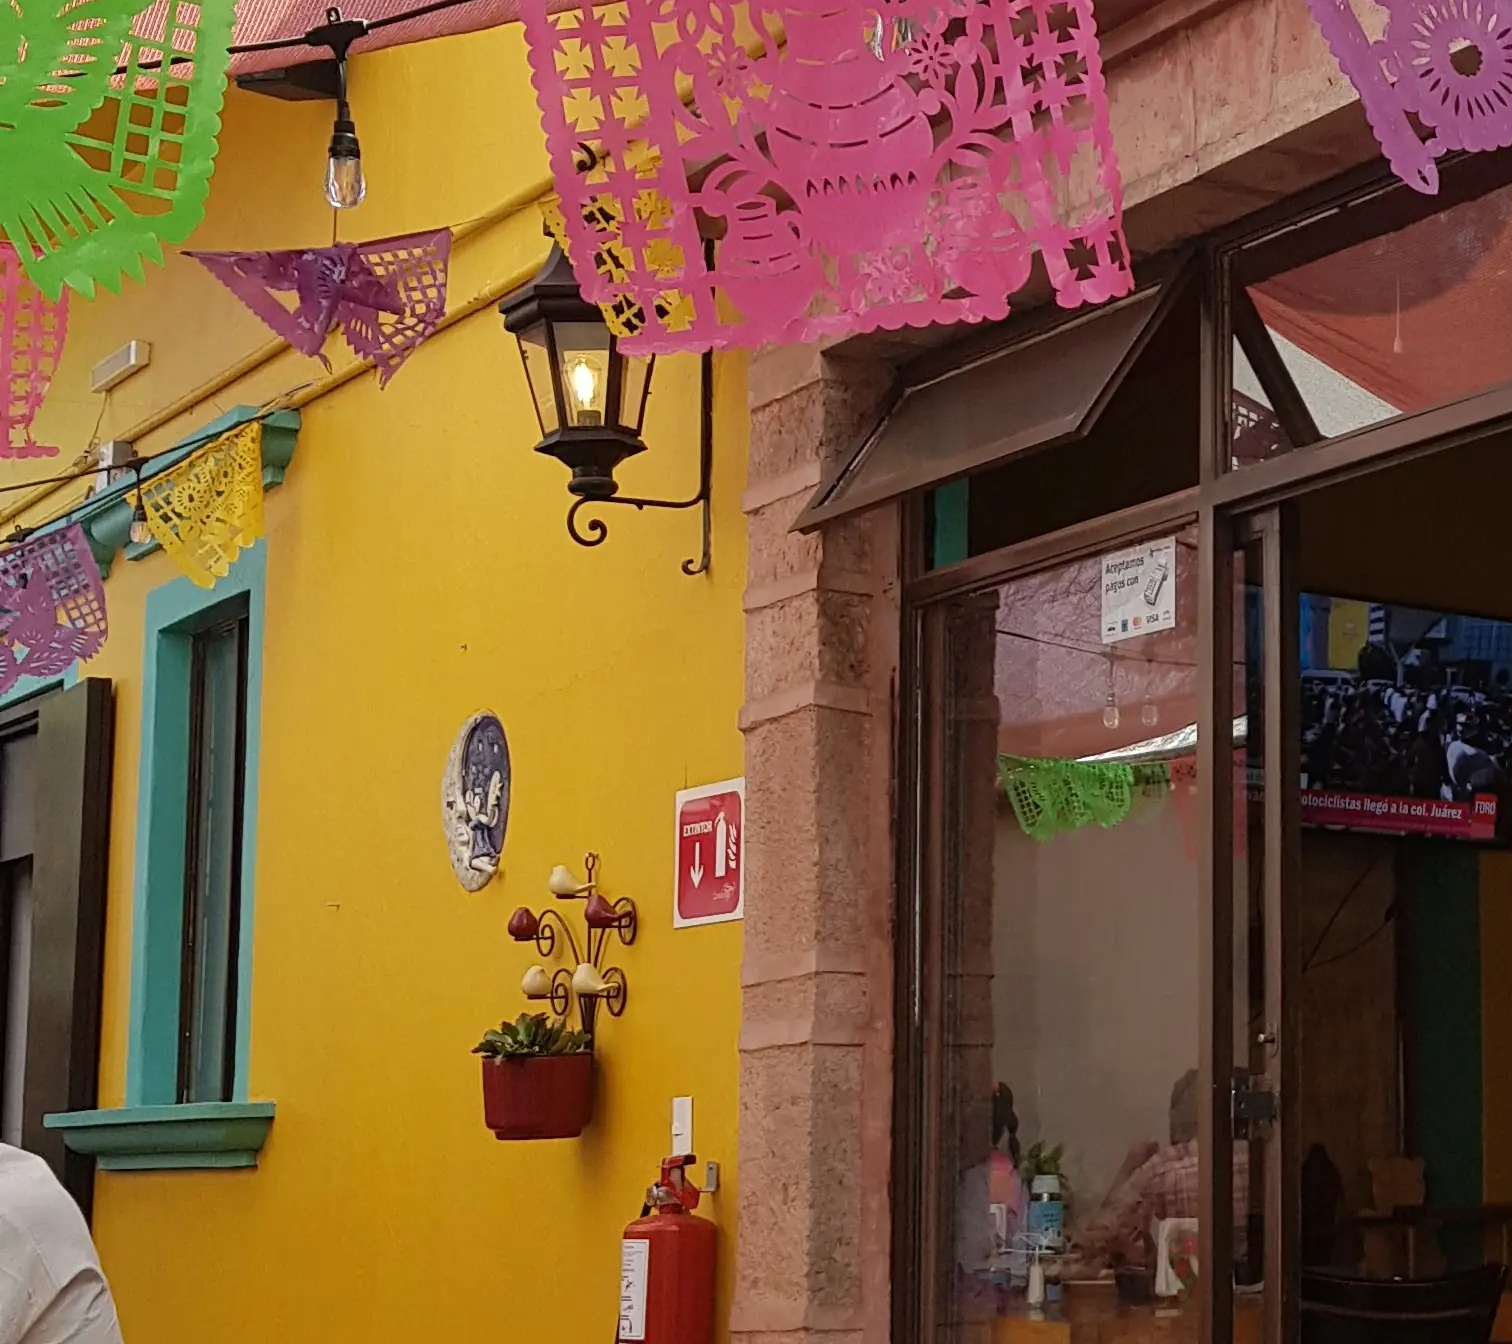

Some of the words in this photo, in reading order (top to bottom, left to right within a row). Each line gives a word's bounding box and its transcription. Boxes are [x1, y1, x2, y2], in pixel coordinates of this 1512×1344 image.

[1105, 556, 1144, 575] Aceptamos
[1301, 793, 1361, 810] otociclistas
[1390, 803, 1397, 813] a
